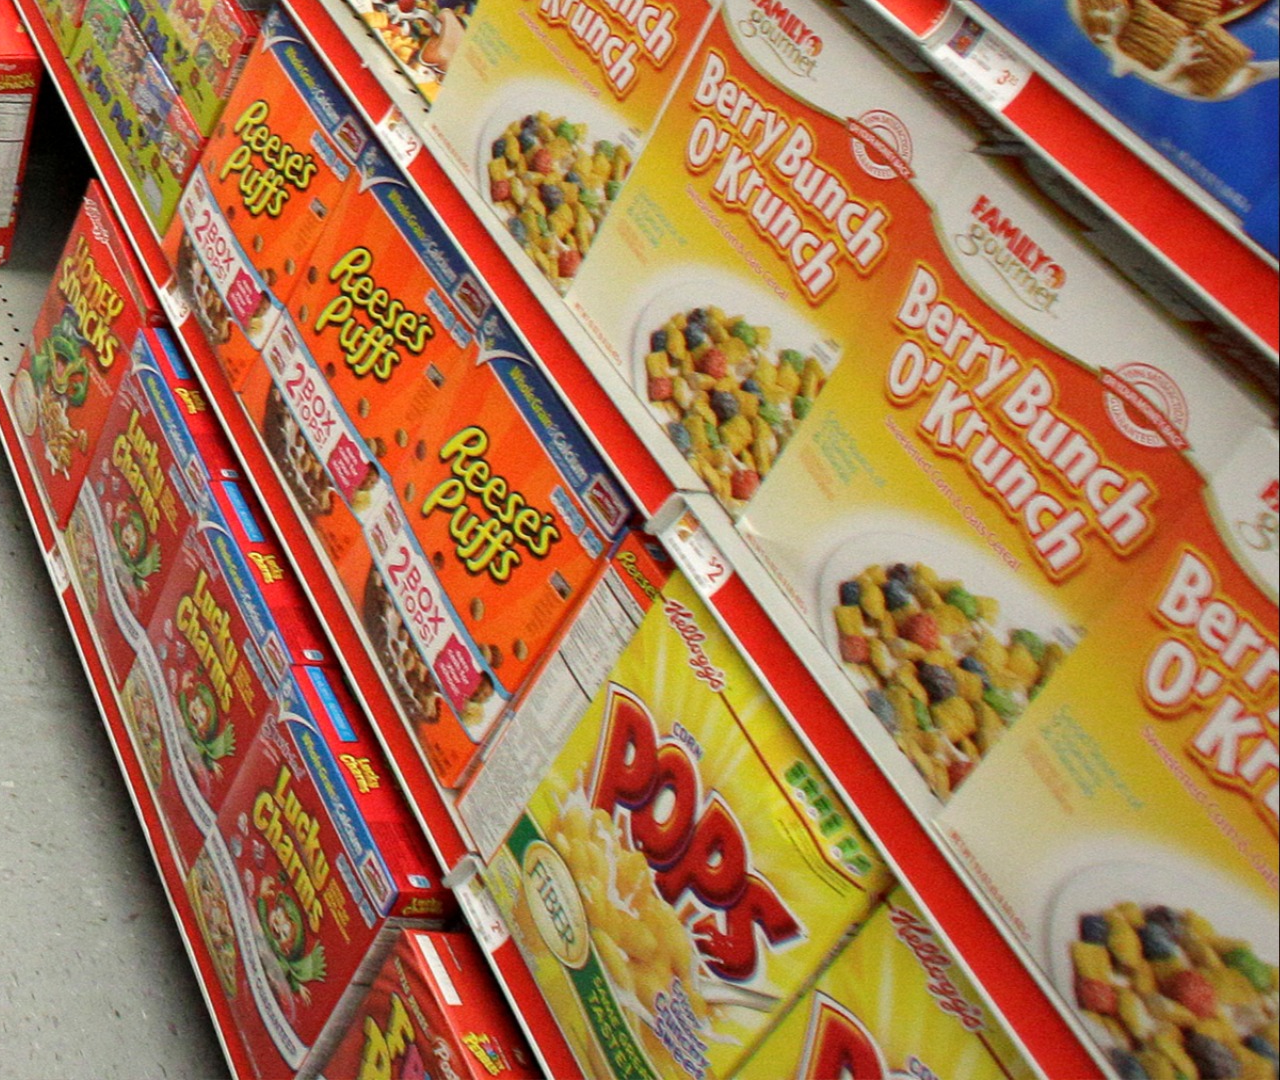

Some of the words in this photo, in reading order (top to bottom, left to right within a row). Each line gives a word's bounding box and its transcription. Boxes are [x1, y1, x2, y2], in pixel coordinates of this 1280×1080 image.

[739, 15, 817, 78] gourmet
[221, 149, 288, 216] Puffs
[235, 101, 316, 189] Reese's
[695, 53, 783, 138] Berry
[774, 115, 887, 270] Bunch
[77, 235, 124, 317] HONEY
[952, 225, 1059, 309] gourmet
[969, 196, 1058, 288] FAMILY
[317, 295, 399, 380] Puffs
[330, 248, 434, 355] Reese's
[304, 377, 337, 431] BOX
[899, 267, 1019, 378] Berry
[1005, 354, 1158, 552] Bunch
[423, 483, 520, 582] Puffs
[441, 428, 561, 558] Reese's
[193, 570, 239, 662] Lucky
[407, 570, 445, 629] BOX
[664, 599, 725, 691] Kellogg's
[177, 596, 234, 711] Charms
[673, 723, 704, 759] CORN
[254, 794, 323, 931] Charms
[278, 767, 330, 884] Lucky
[590, 683, 811, 982] POPS
[889, 905, 985, 1031] Kellogg's
